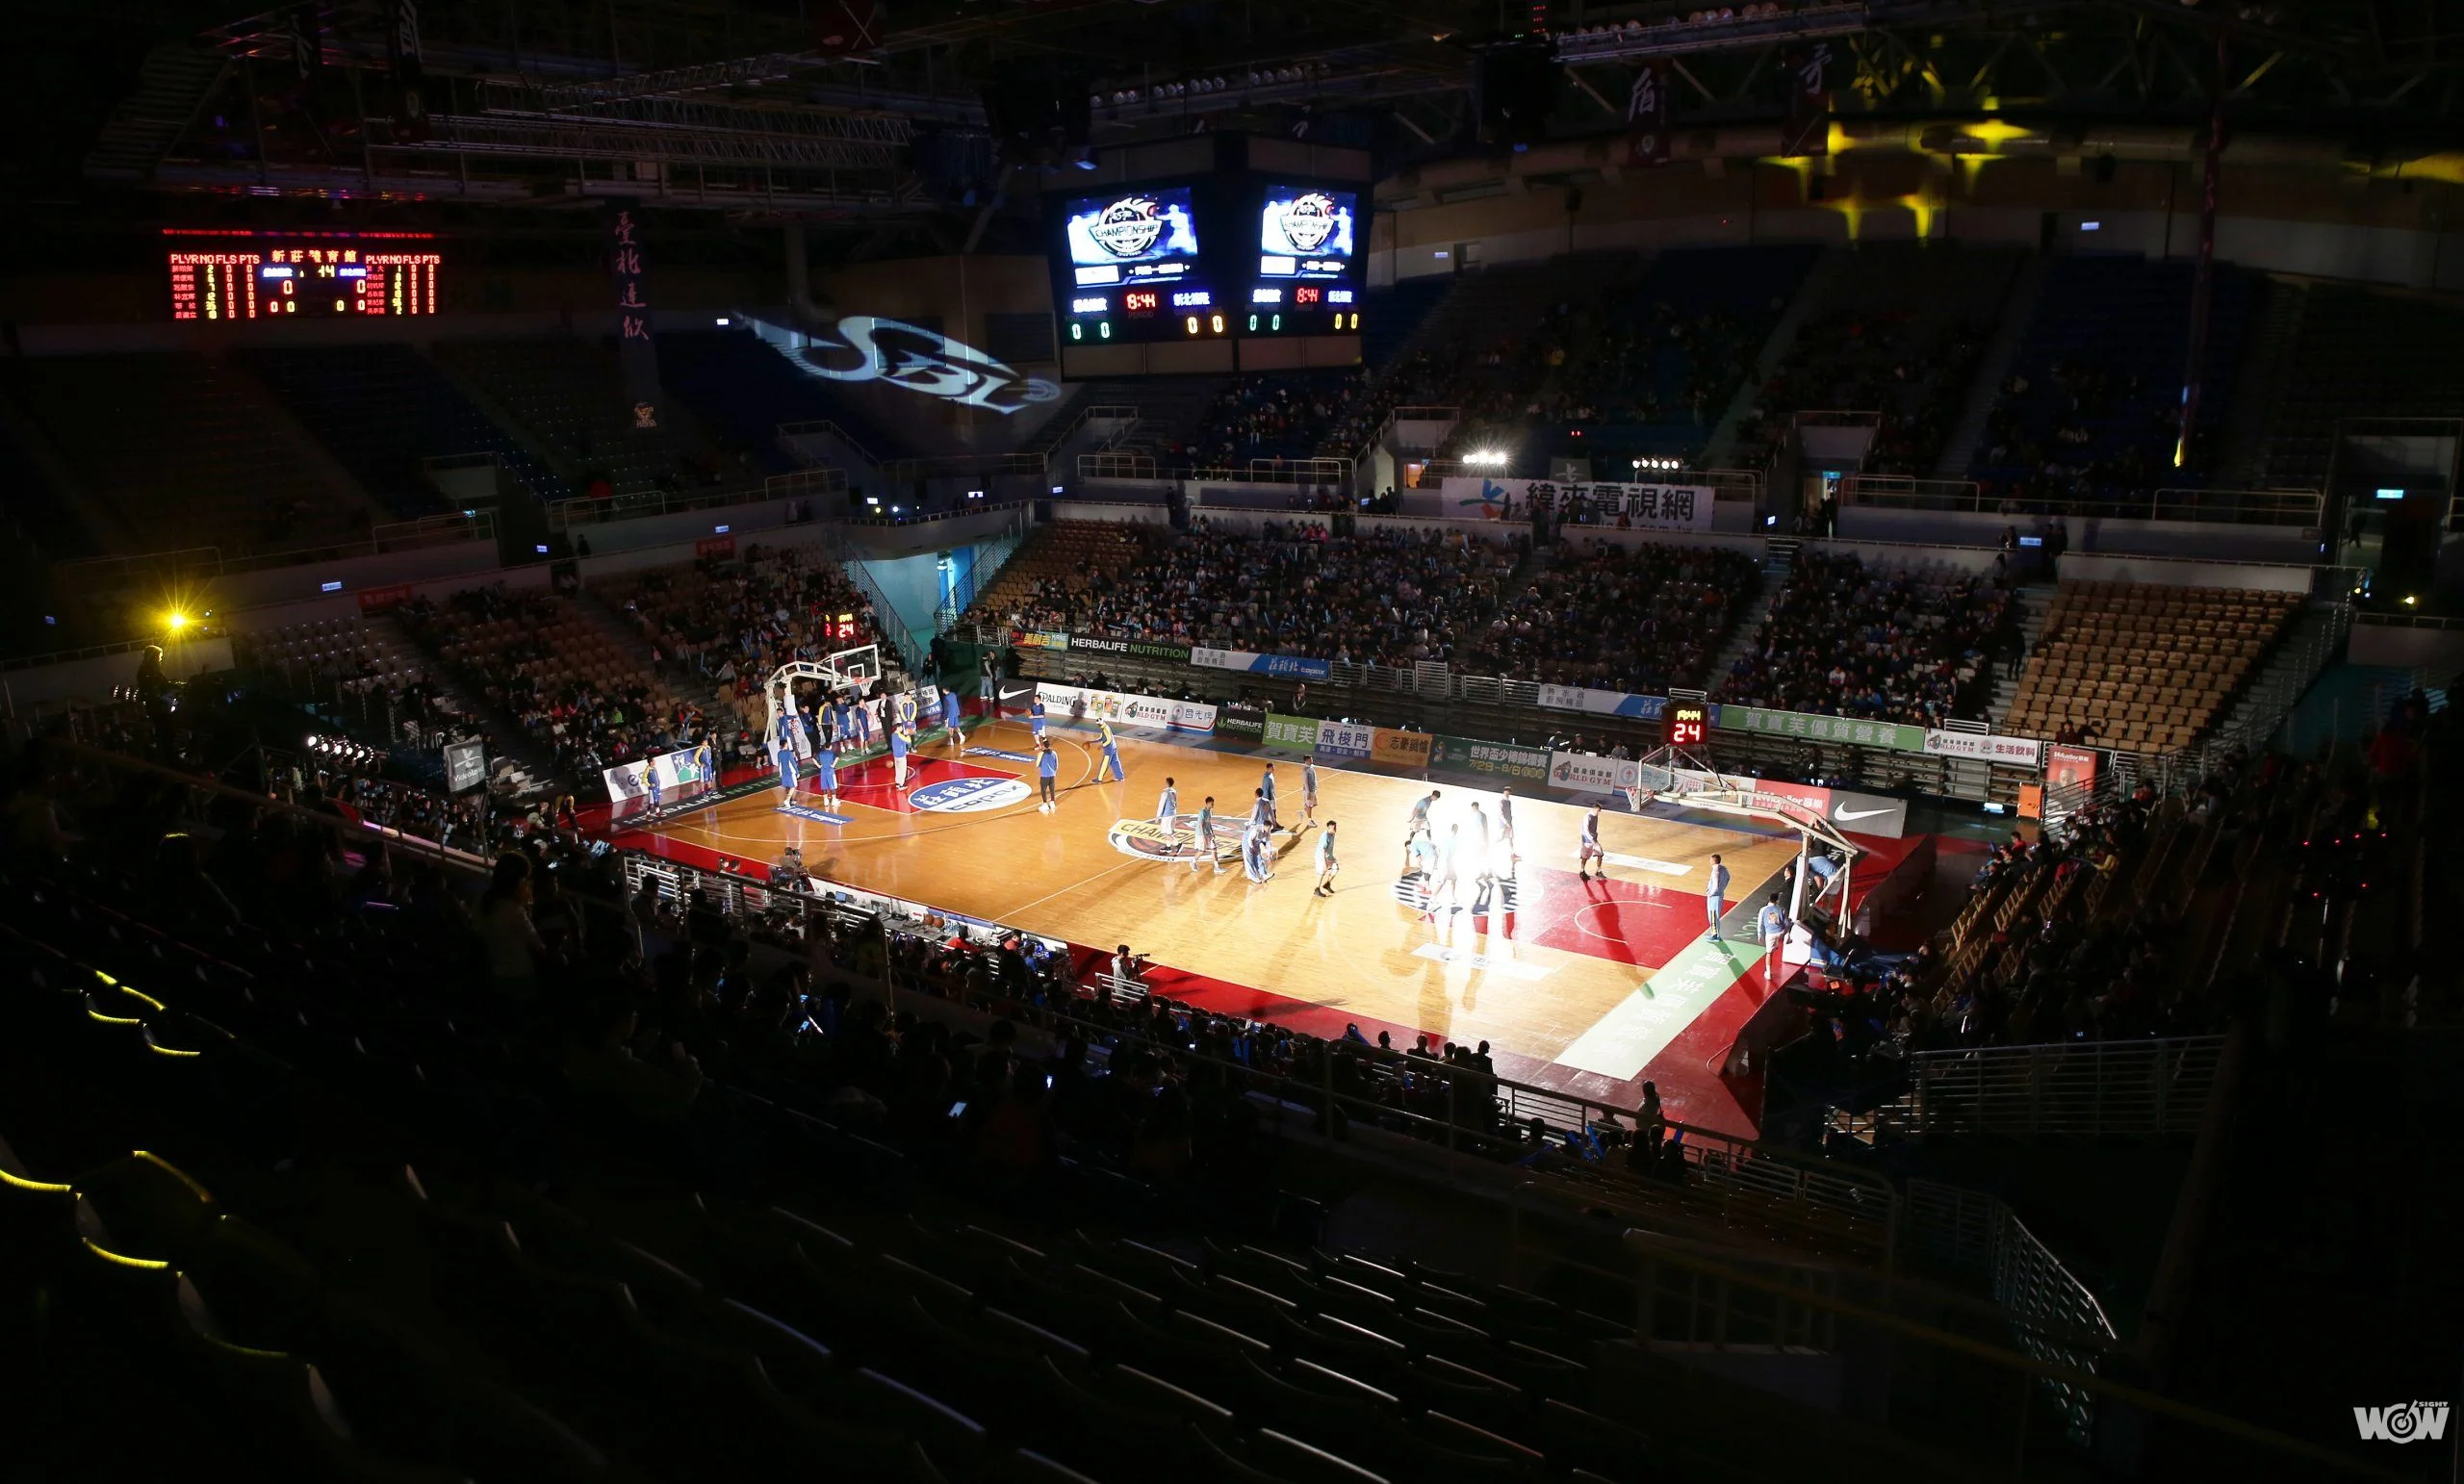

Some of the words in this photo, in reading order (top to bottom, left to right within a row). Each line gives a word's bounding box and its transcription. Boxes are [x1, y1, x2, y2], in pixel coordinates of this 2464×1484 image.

[1095, 224, 1158, 237] CHAMPIONSHIP
[170, 254, 199, 265] PLYR
[199, 254, 215, 265] NO
[216, 254, 238, 265] FLS
[239, 254, 260, 265] PTS
[366, 255, 390, 264] PLYR
[390, 255, 402, 264] NO
[402, 255, 421, 264] FLS
[423, 255, 440, 264] PTS
[283, 279, 293, 294] 0
[356, 279, 366, 294] 0
[1126, 294, 1156, 310] 8:44
[1297, 288, 1319, 303] 8:44
[270, 301, 278, 313] 0
[287, 301, 295, 312] 0
[336, 300, 345, 311] 0
[357, 299, 365, 311] 0
[1187, 317, 1198, 334] 0
[1211, 316, 1224, 333] 0
[1249, 315, 1257, 331] 0
[1272, 315, 1280, 331] 0
[1335, 314, 1342, 329] 0
[1350, 314, 1358, 329] 0
[1072, 323, 1082, 340] 0
[1100, 322, 1111, 339] 0
[839, 624, 854, 638] 24
[1070, 637, 1128, 652] HERBALIFE
[1130, 643, 1190, 659] NUTRITION
[1226, 724, 1262, 734] NUTRITION
[1227, 718, 1263, 729] HERBALIFE
[1267, 721, 1317, 744] 賀寶芙
[1322, 729, 1369, 749] 飛梭門
[1674, 723, 1701, 742] 24
[1995, 744, 2035, 757] 生活飲料
[1589, 777, 1610, 786] GYM
[913, 779, 994, 806] 莊頭北
